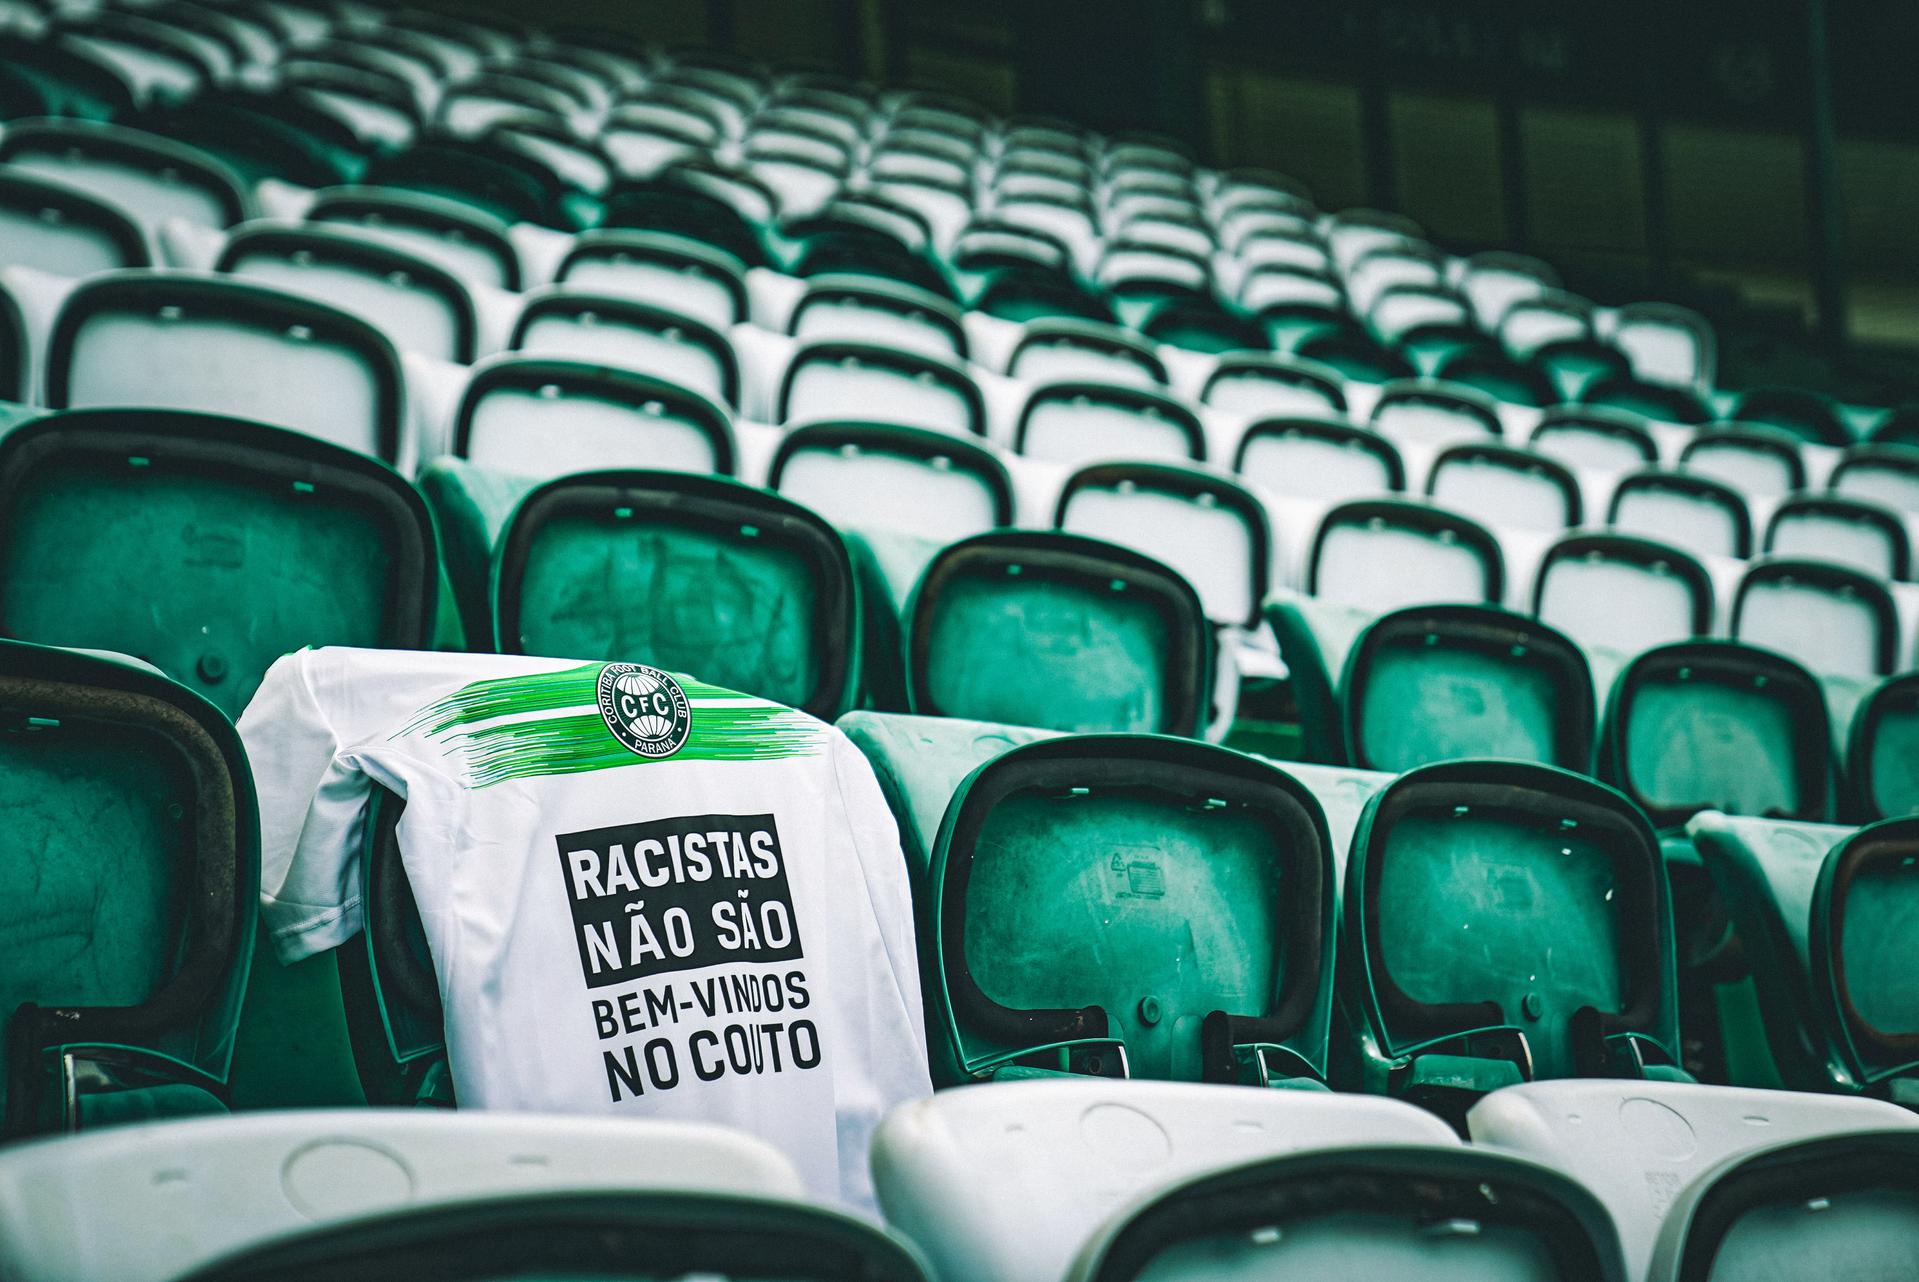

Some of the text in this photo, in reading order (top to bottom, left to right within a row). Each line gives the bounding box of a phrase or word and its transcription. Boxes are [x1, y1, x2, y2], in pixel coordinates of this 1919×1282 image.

[601, 664, 687, 724] CORITIBA FOOT BALL CLUB
[621, 692, 669, 718] CFC
[634, 734, 676, 753] PARANÁ
[567, 830, 779, 900] RACISTAS
[583, 889, 791, 974] NÃO SÃO
[592, 970, 810, 1040] BEM-VINDOS
[603, 1019, 822, 1103] NO COUTO
